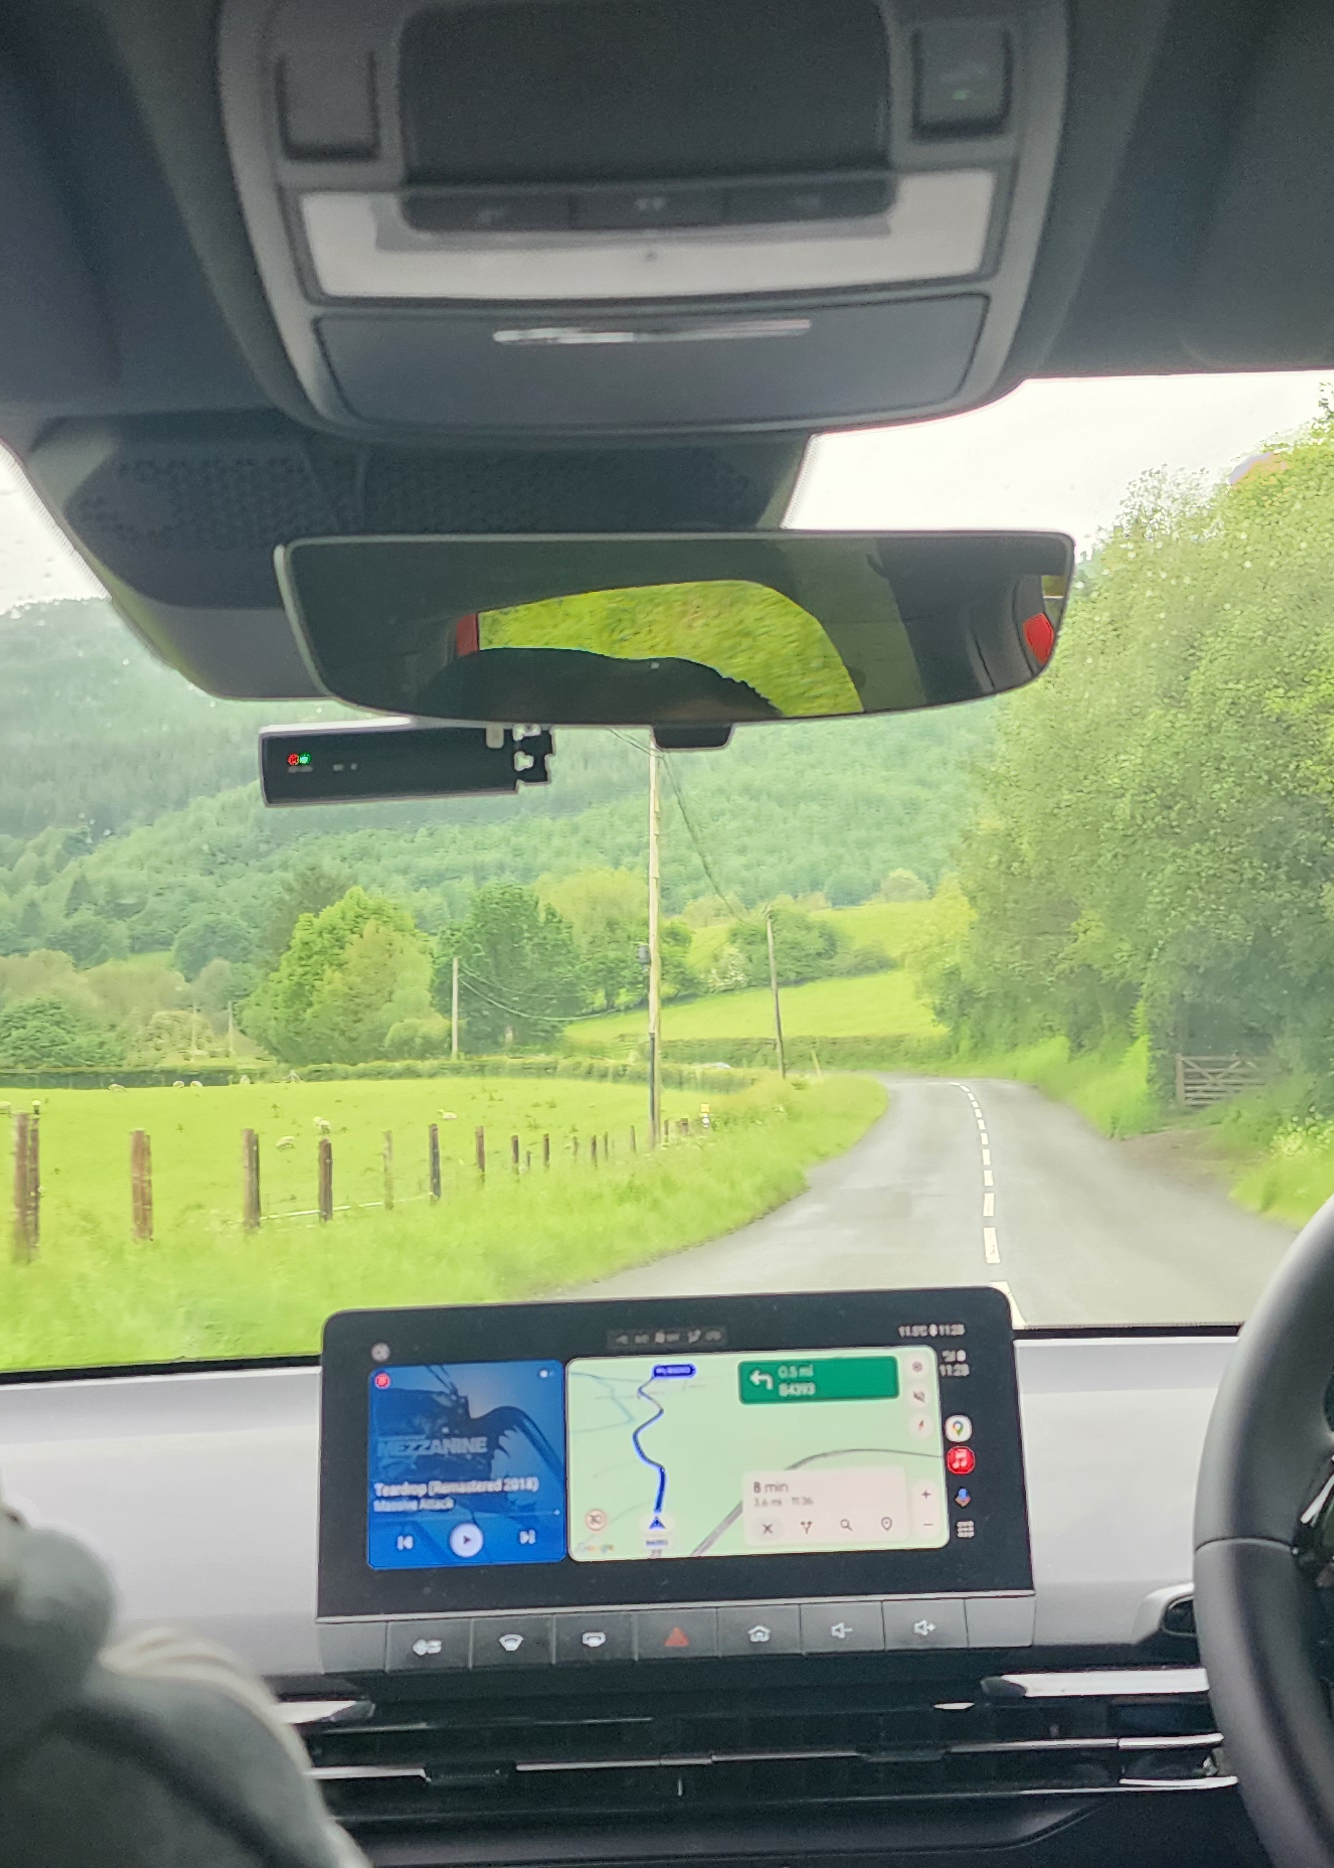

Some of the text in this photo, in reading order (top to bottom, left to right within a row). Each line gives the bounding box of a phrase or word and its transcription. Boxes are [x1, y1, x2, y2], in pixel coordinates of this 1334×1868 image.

[799, 1364, 814, 1377] mi
[378, 1437, 487, 1457] MEZZANINE
[374, 1476, 540, 1497] Teardrop (Remastered 2018)
[753, 1481, 789, 1493] 8 min
[373, 1497, 455, 1512] Massive Attack
